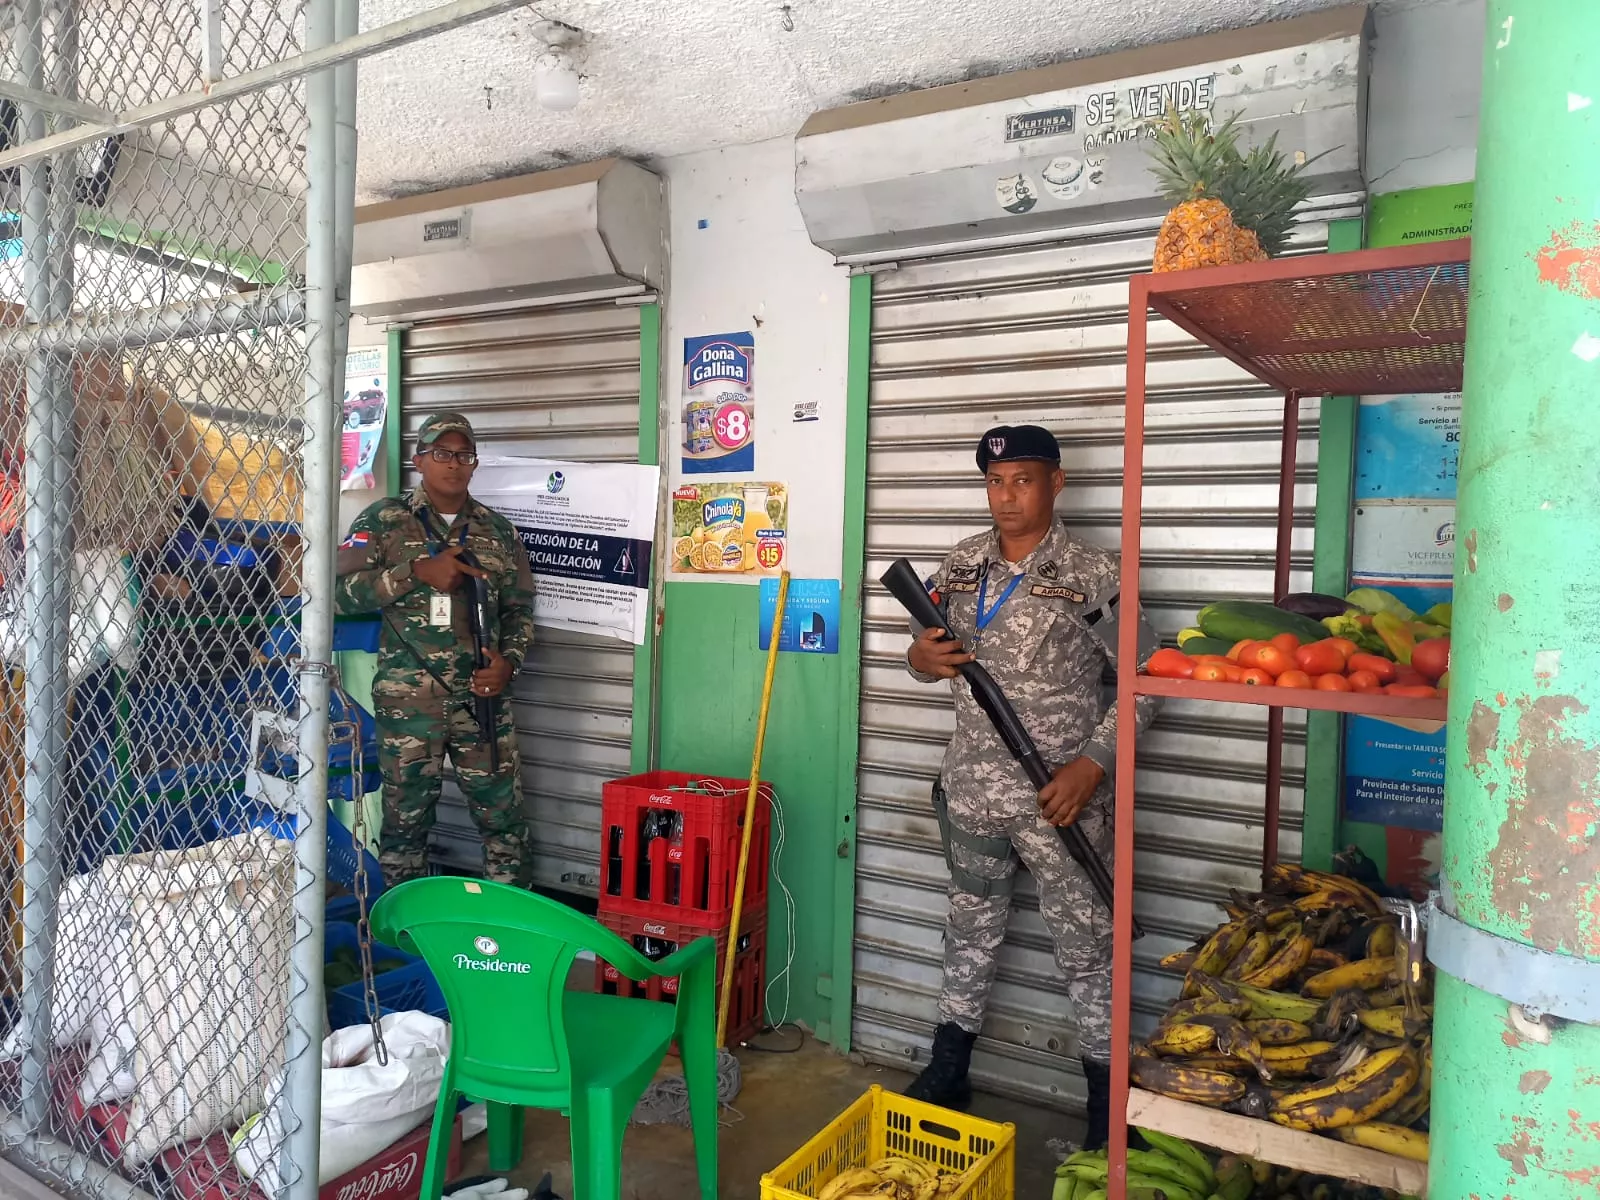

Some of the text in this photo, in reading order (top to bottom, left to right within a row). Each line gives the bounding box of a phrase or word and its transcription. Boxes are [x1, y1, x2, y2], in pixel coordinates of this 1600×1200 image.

[1086, 77, 1210, 126] SE VENDE
[347, 352, 381, 363] OTELLAS
[702, 347, 735, 363] Doña
[693, 362, 744, 381] Gallina
[717, 410, 746, 440] $8
[675, 489, 696, 497] NUEVO
[568, 537, 585, 550] DE
[584, 538, 599, 552] LA
[761, 547, 779, 563] $15
[1041, 588, 1075, 599] ARMADA
[1375, 741, 1404, 750] Presentar
[1412, 744, 1439, 753] TARJETA
[1411, 768, 1444, 780] Servicio
[1362, 779, 1399, 790] Provincia
[1399, 782, 1410, 791] de
[1411, 783, 1435, 794] Santo
[1356, 789, 1374, 799] Para
[1374, 791, 1382, 799] el
[1383, 792, 1414, 803] interior
[1415, 795, 1429, 804] del
[452, 953, 531, 974] Presidente
